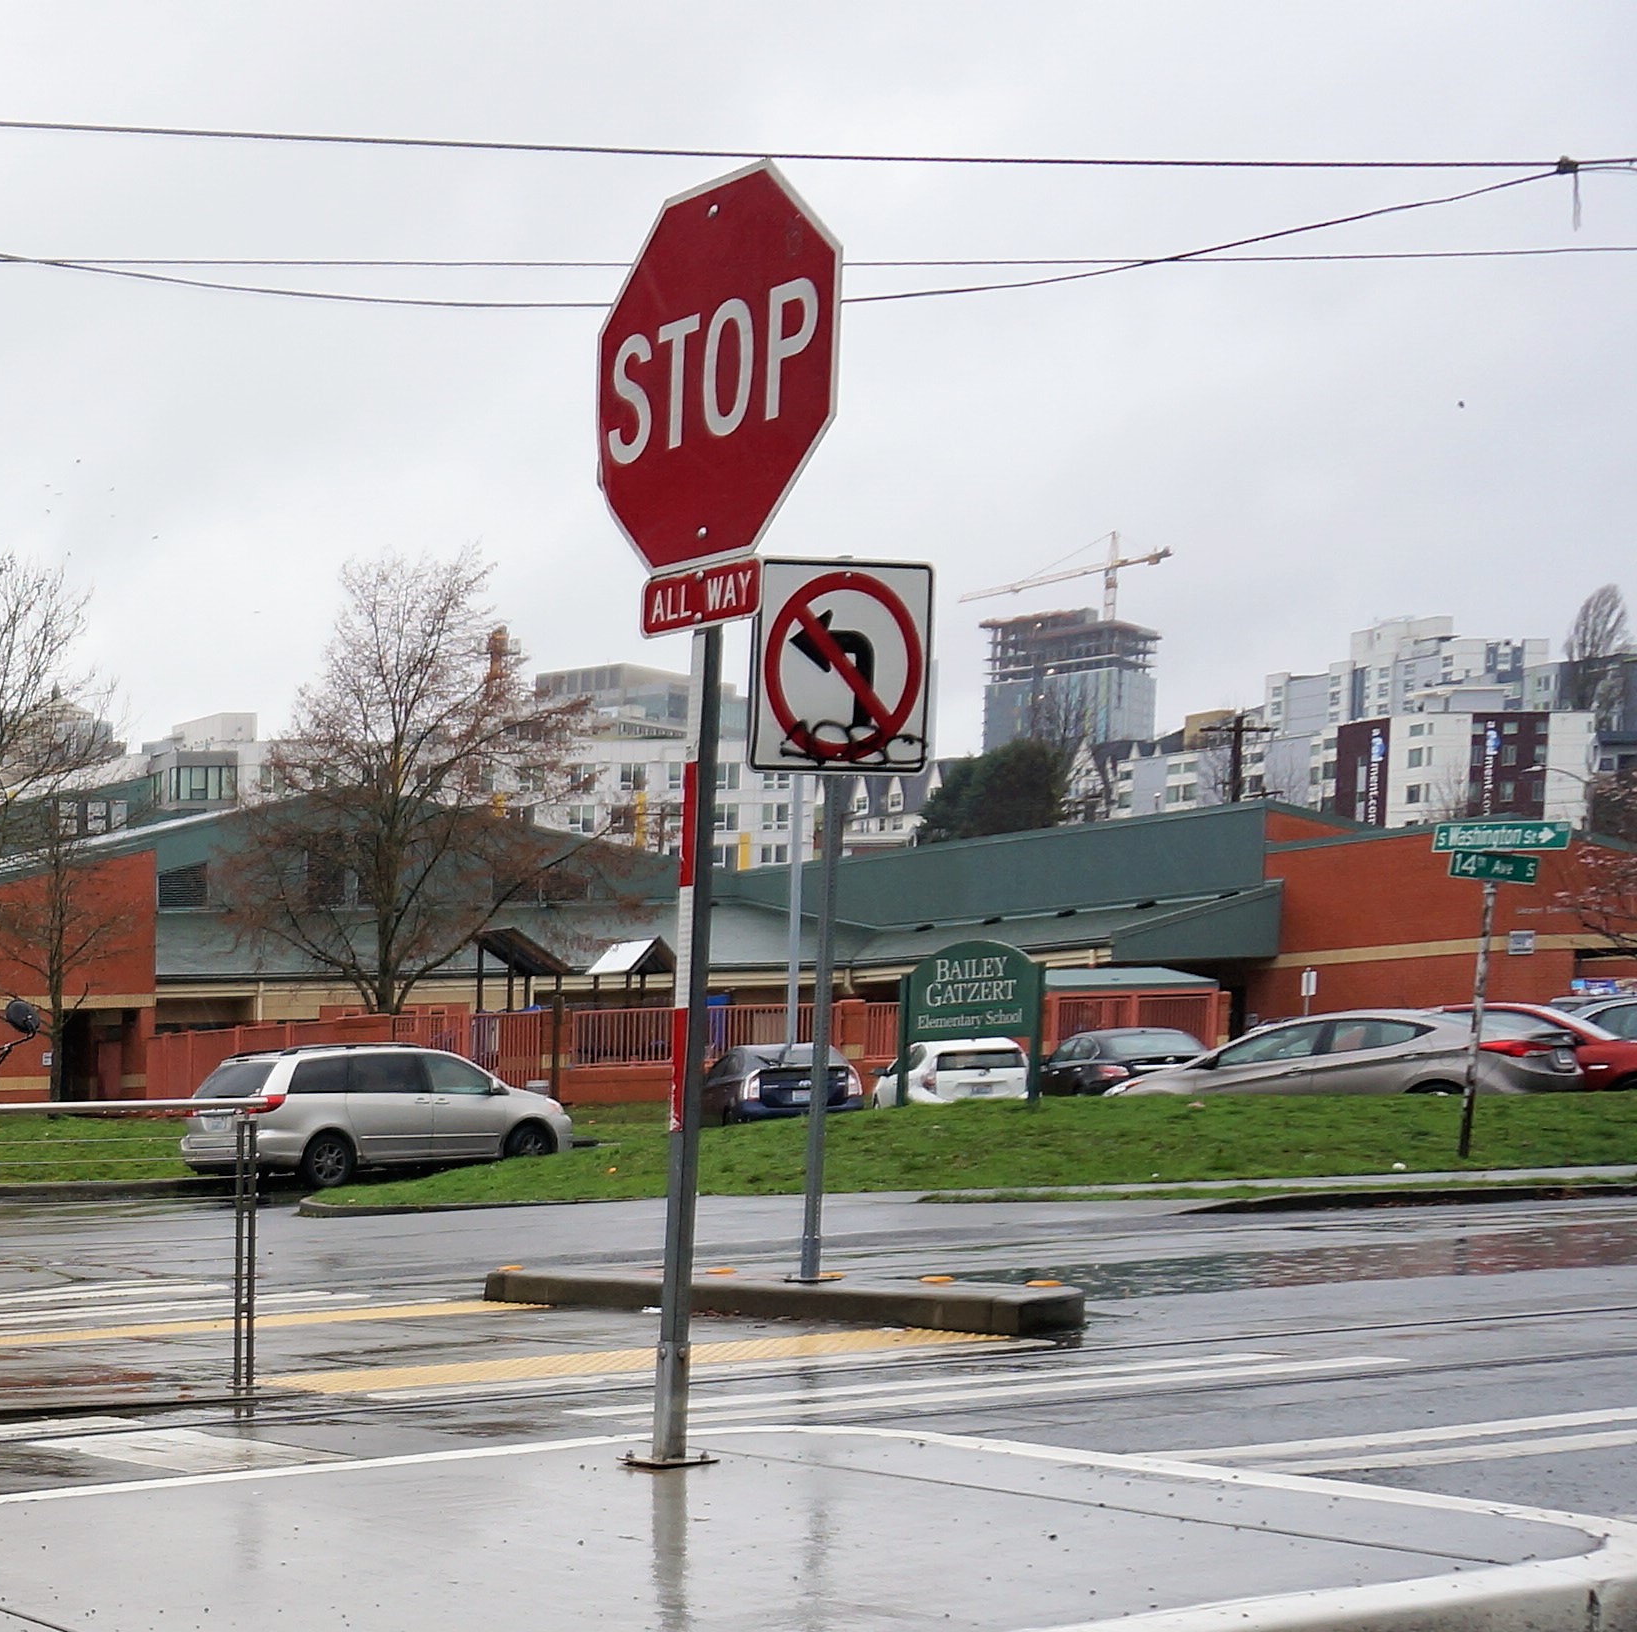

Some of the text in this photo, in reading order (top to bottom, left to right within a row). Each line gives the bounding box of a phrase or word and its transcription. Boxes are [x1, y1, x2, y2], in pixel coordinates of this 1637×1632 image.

[608, 277, 819, 464] STOP
[651, 570, 752, 623] ALL WAY
[1437, 826, 1537, 848] S Washington St
[1491, 860, 1514, 875] Ave
[1526, 863, 1536, 877] S
[936, 956, 1009, 982] BAILEY
[926, 980, 1017, 1007] GATZERT
[917, 1008, 1023, 1029] Elementary School
